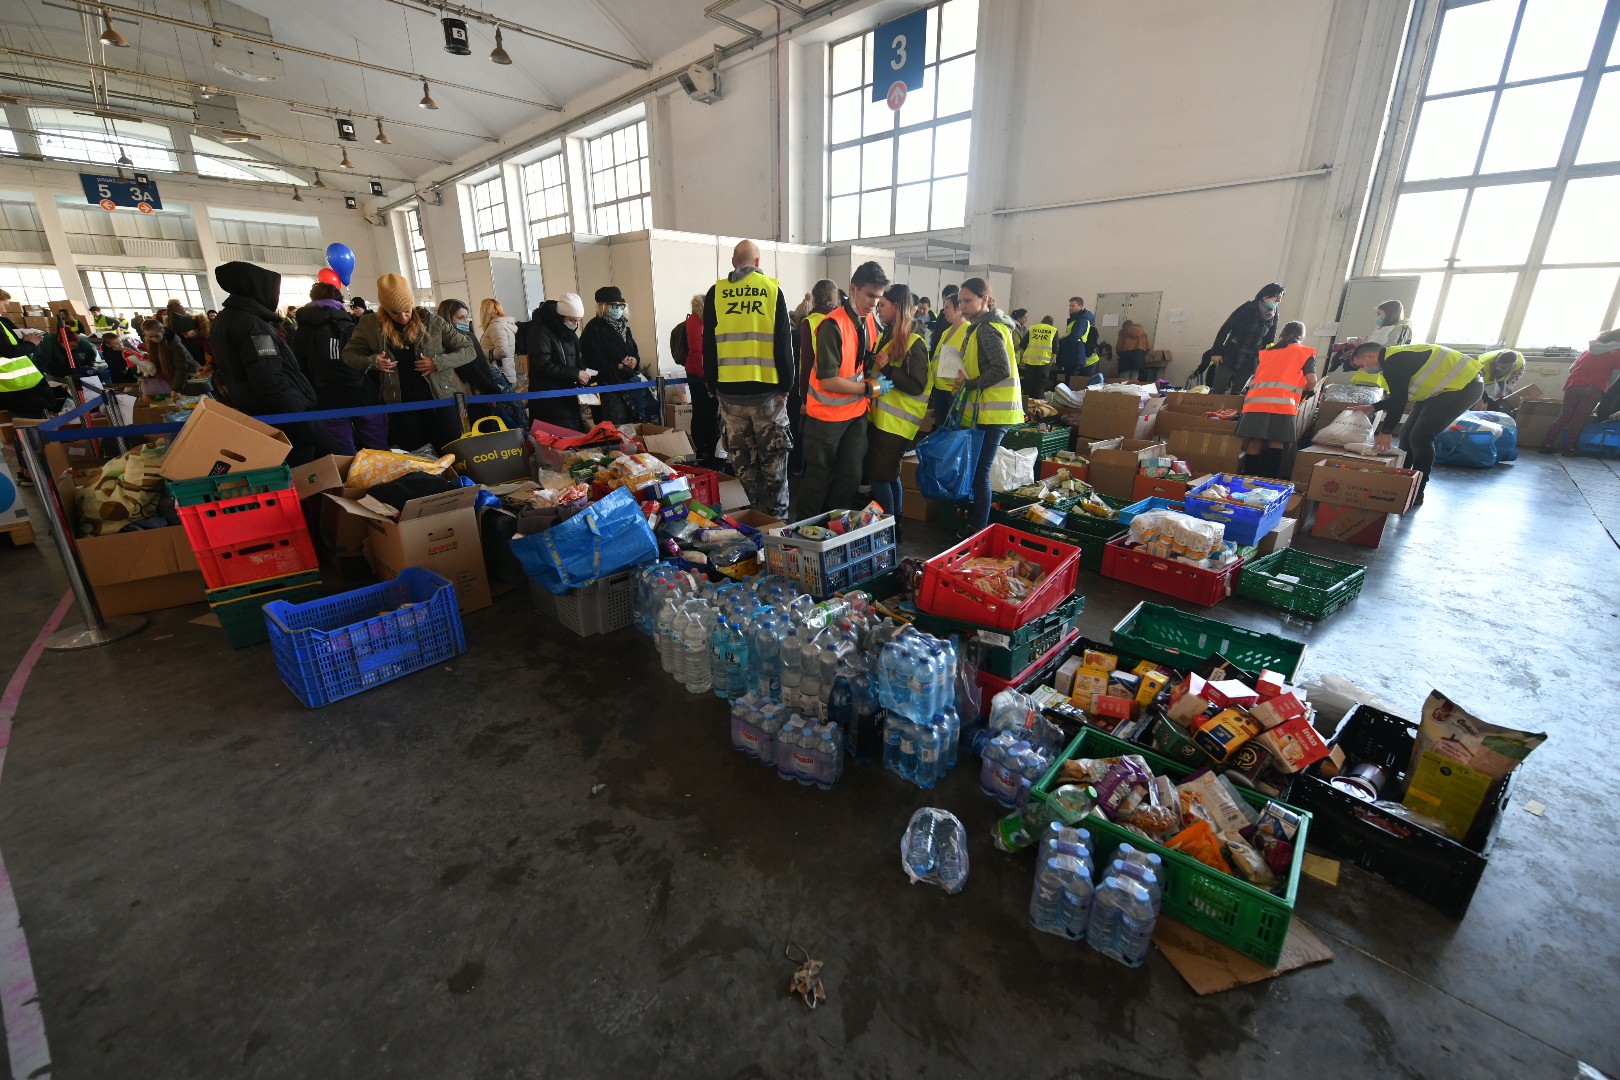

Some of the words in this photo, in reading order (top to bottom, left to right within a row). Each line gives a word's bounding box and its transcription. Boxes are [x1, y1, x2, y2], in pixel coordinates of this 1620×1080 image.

[456, 29, 463, 38] 5
[890, 34, 907, 71] 3
[97, 183, 112, 199] 5
[129, 186, 154, 202] 3A
[722, 284, 769, 299] SŁUŻBA
[724, 300, 766, 316] ZHR
[473, 449, 499, 463] cool
[501, 447, 523, 460] grey
[428, 542, 452, 554] toom
[1301, 727, 1318, 747] inka
[793, 752, 814, 764] Saskia
[995, 769, 1017, 787] Saskia
